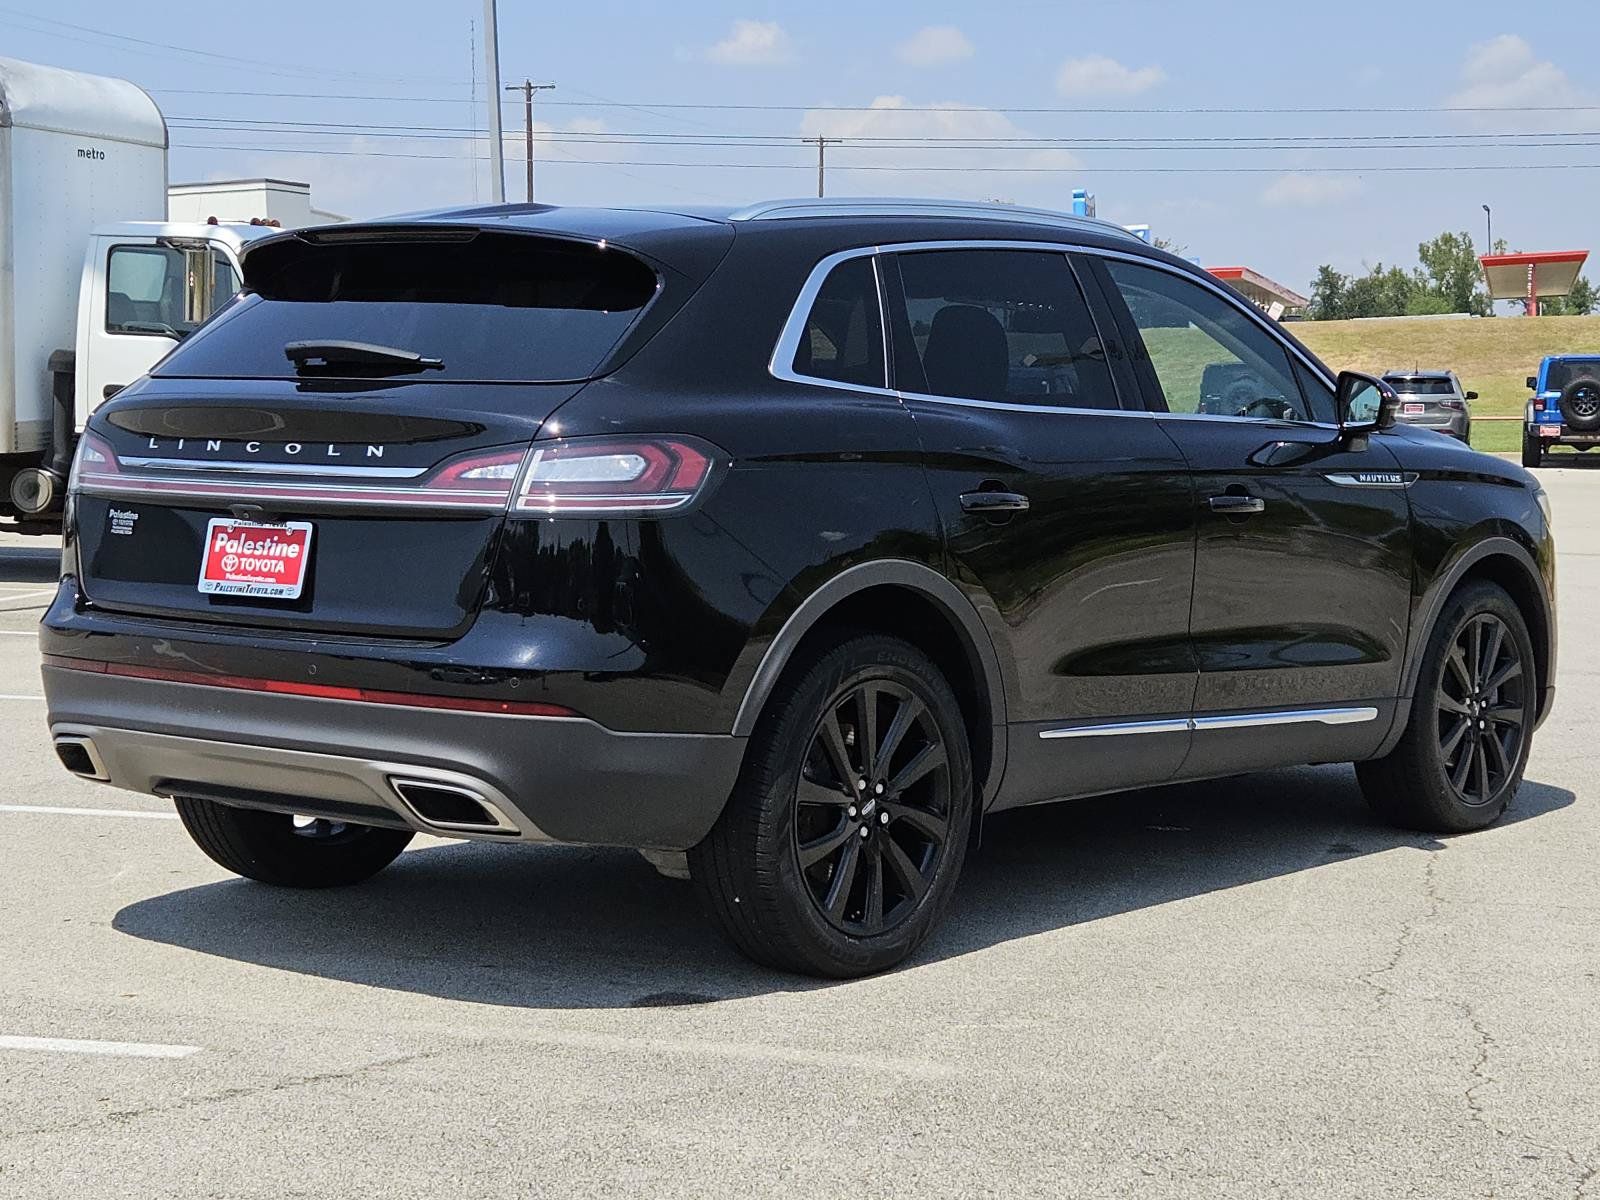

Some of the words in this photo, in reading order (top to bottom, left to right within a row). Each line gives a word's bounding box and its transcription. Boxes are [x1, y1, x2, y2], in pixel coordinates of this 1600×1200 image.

[77, 147, 105, 161] metro
[148, 437, 385, 459] LINCOLN
[1359, 474, 1401, 482] NAUTILUS
[214, 532, 300, 558] Palestine
[239, 557, 285, 573] TOYOTA
